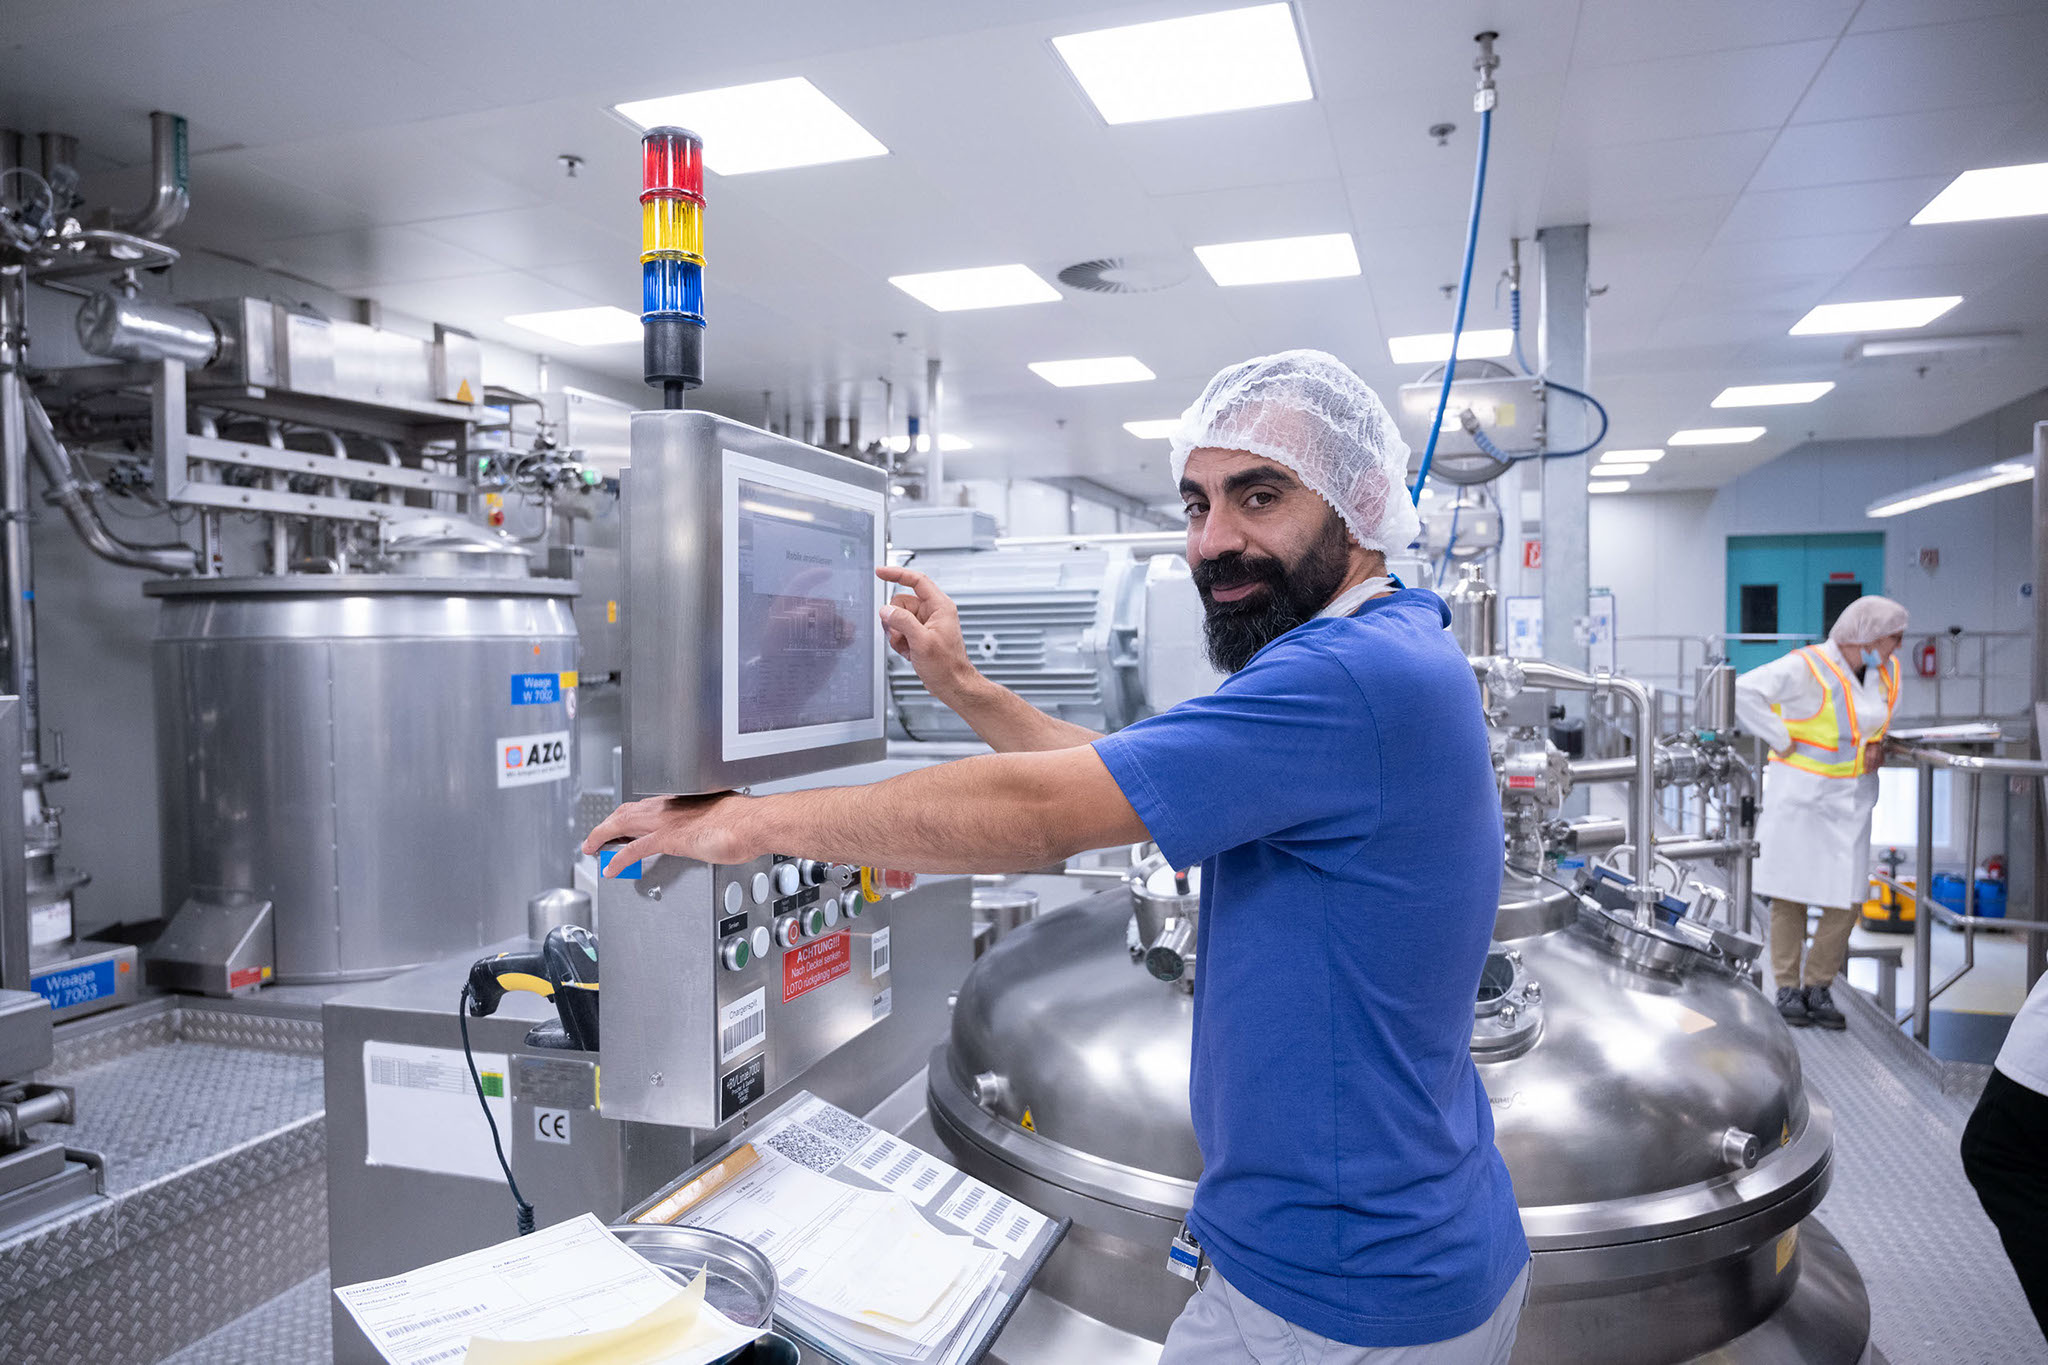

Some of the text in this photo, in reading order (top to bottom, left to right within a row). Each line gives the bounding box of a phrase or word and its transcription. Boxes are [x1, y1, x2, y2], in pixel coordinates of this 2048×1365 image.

[524, 677, 552, 691] Waage
[797, 936, 840, 963] ACHTUNG!!!
[791, 964, 806, 979] Nach
[806, 957, 823, 973] Deckel
[823, 950, 841, 966] senken
[46, 970, 96, 991] Waage
[786, 960, 850, 996] LOTO rückgängig machen
[65, 982, 98, 1005] 7003
